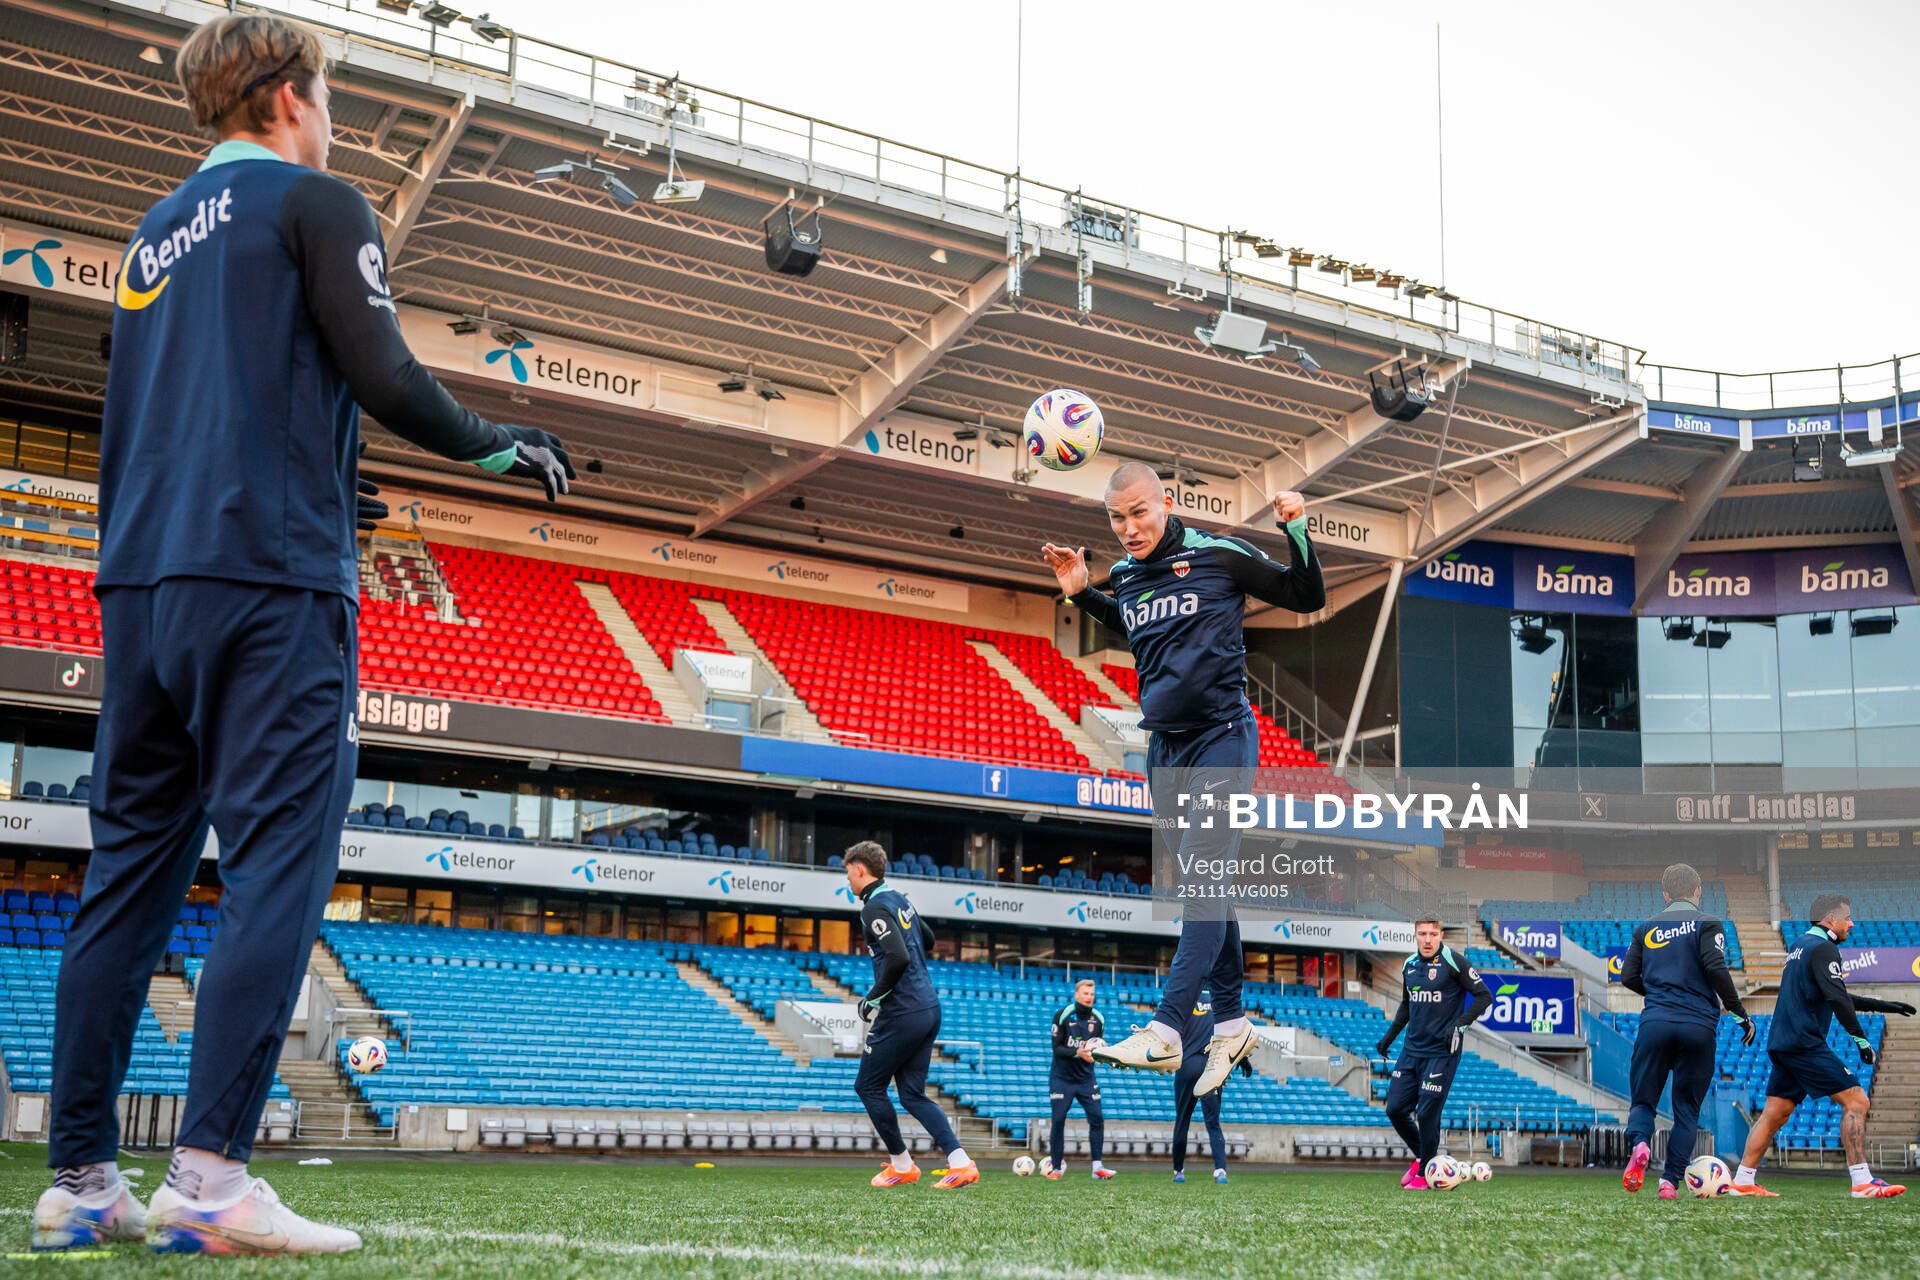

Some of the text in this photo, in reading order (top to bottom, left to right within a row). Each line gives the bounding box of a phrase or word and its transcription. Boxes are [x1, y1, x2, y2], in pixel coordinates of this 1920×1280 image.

[139, 187, 233, 286] Bendit
[63, 256, 119, 291] tel
[535, 354, 642, 399] telenor
[884, 425, 975, 465] telenor
[421, 506, 473, 525] telenor
[550, 527, 599, 546] telenor
[1307, 513, 1370, 543] elenor
[671, 548, 718, 565] telenor
[786, 565, 830, 583] telenor
[1536, 564, 1613, 596] bama
[1667, 568, 1751, 599] bama
[1801, 561, 1889, 593] bama
[894, 583, 936, 600] telenor
[703, 663, 748, 681] telenor
[357, 690, 451, 733] dslaget
[1676, 792, 1856, 824] @nff_landslag
[452, 852, 516, 871] telenor
[596, 864, 656, 883] telenor
[731, 876, 787, 893] telenor
[975, 897, 1025, 913] telenor
[1086, 906, 1133, 922] telenor
[1291, 922, 1332, 937] telenor
[1655, 920, 1696, 943] Bendit
[1842, 950, 1878, 972] endit
